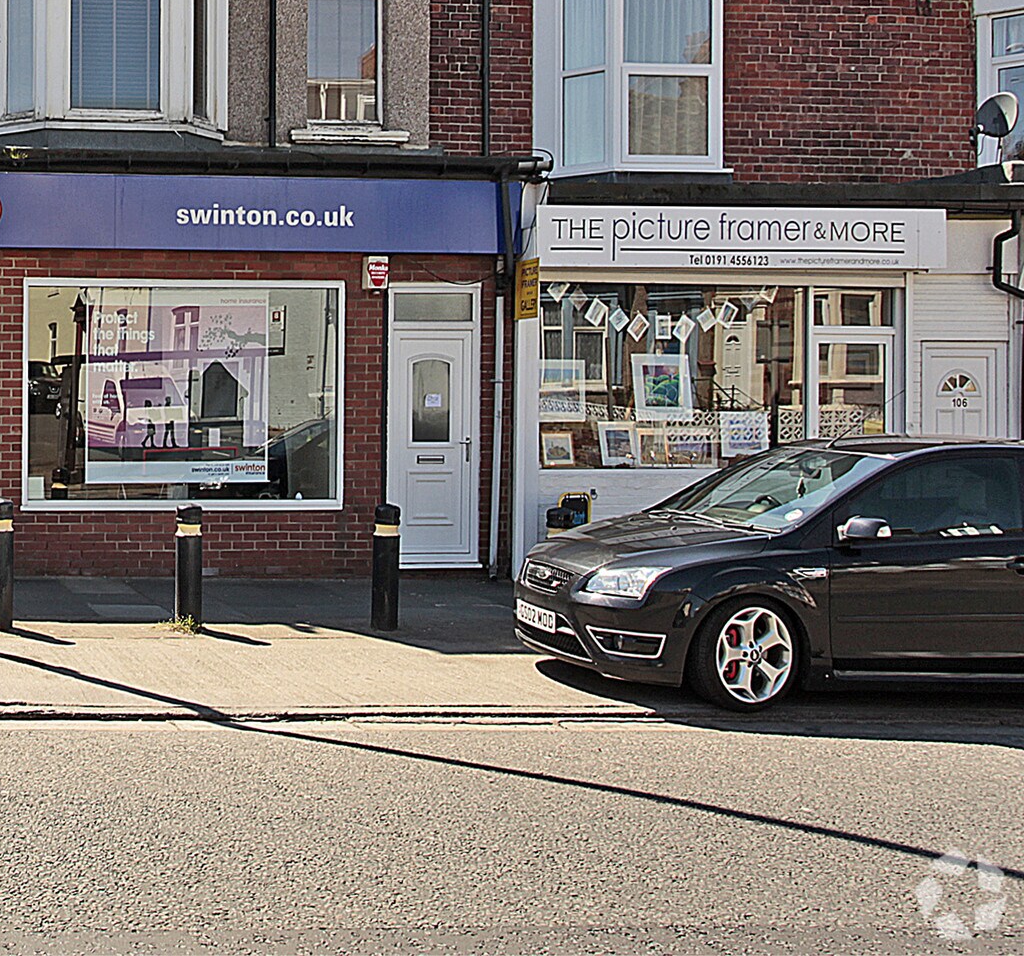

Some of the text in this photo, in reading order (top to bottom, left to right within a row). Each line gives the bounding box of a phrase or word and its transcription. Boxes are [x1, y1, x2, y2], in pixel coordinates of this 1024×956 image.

[176, 203, 354, 227] swinton.co.uk
[552, 218, 604, 239] THE
[612, 212, 710, 261] picture
[689, 254, 769, 266] Tel 0191 4556123
[952, 397, 968, 408] 106
[234, 463, 266, 472] swinton
